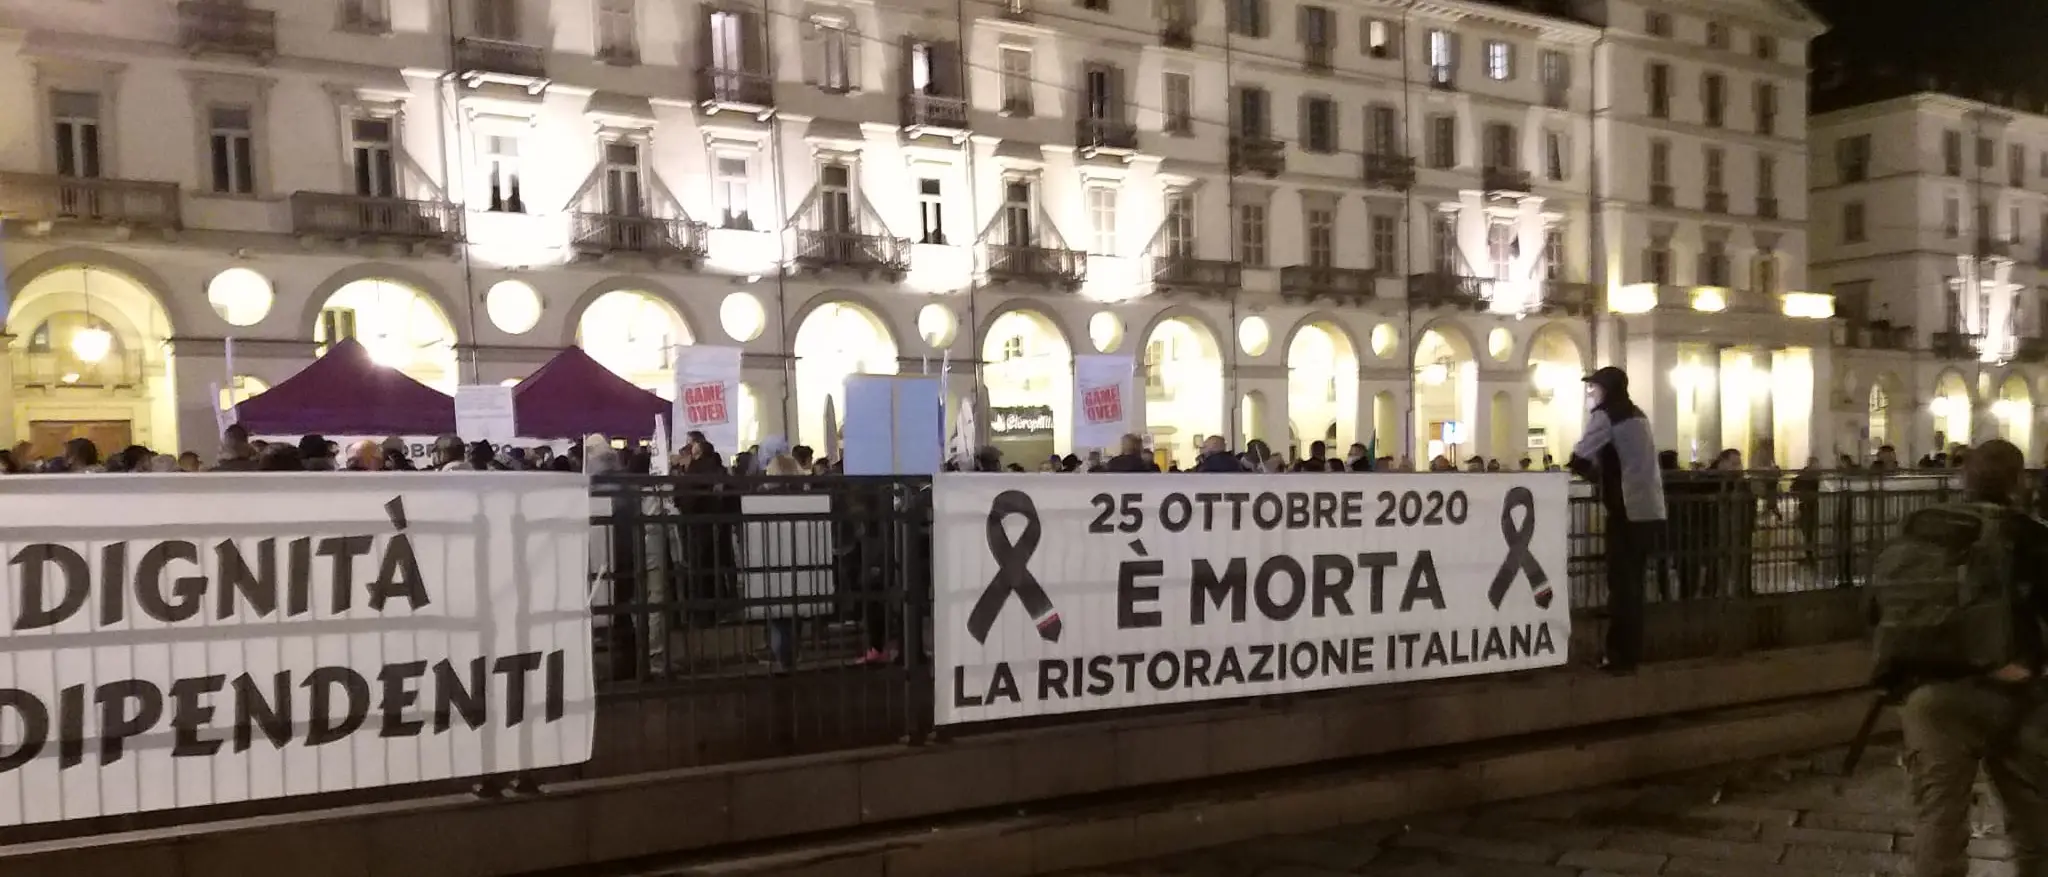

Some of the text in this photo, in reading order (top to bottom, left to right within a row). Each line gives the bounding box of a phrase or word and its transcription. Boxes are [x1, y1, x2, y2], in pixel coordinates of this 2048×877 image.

[685, 383, 722, 406] GAME
[687, 403, 725, 424] OVER
[1084, 387, 1118, 407] GAME
[1087, 404, 1120, 421] OVER
[1088, 489, 1469, 534] 25 OTTOBRE 2020
[8, 495, 431, 631] DIGNITÀ
[1117, 538, 1447, 630] È MORTA
[954, 621, 1556, 709] LA RISTORAZIONE ITALIANA
[0, 649, 566, 773] DIPENDENTI
